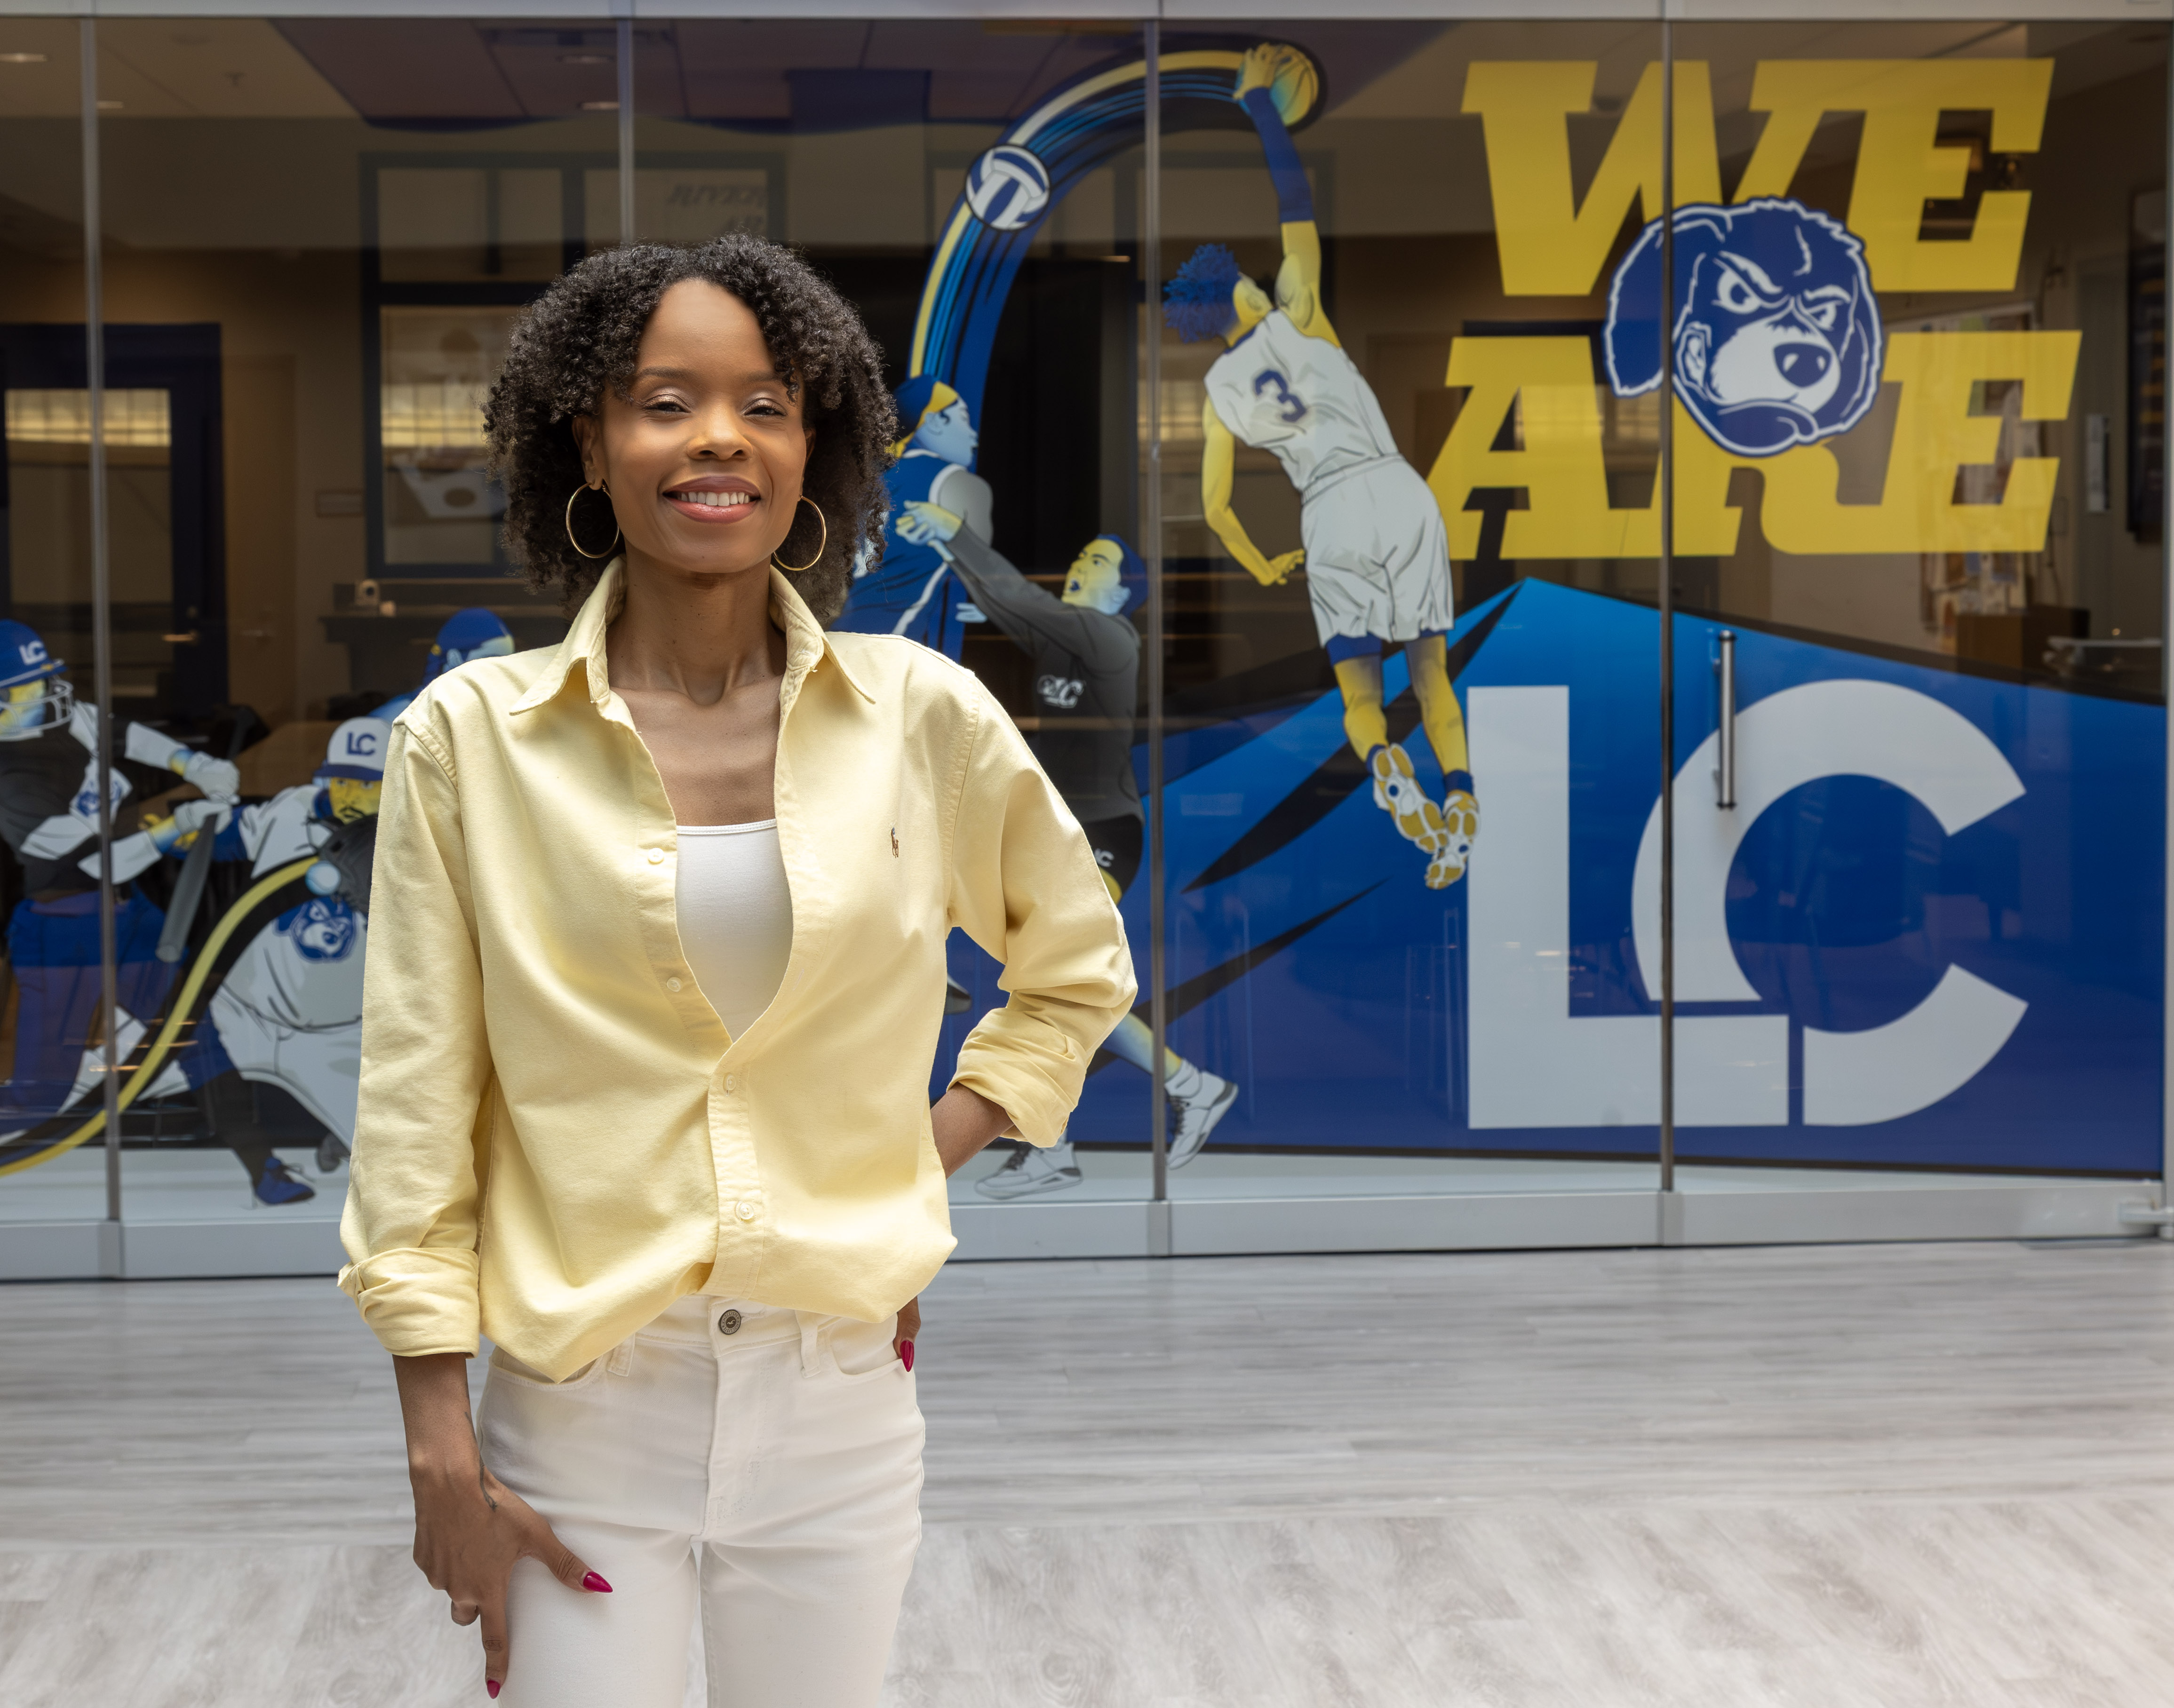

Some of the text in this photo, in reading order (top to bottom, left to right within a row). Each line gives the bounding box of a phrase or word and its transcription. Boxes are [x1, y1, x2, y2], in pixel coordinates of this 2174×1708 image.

[1461, 57, 2055, 295] WE
[1255, 369, 1307, 422] 3
[19, 641, 47, 666] LC
[347, 732, 376, 756] LC
[1466, 678, 2029, 1128] LC
